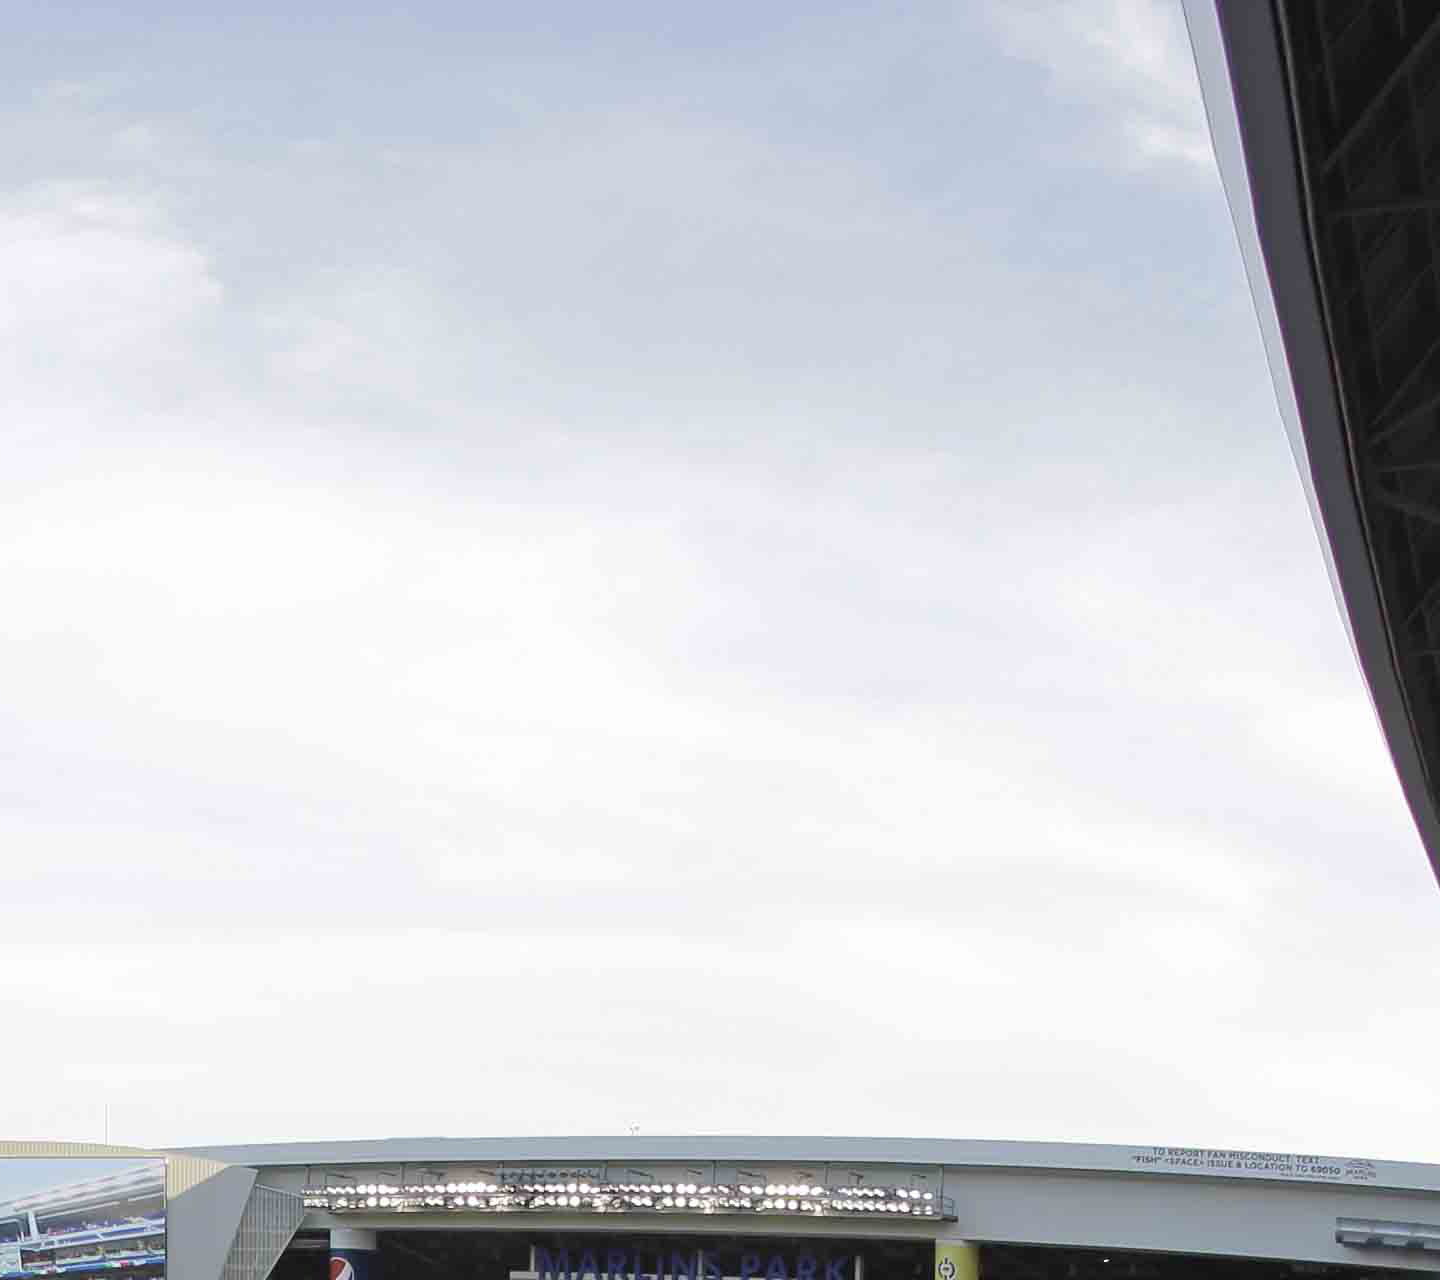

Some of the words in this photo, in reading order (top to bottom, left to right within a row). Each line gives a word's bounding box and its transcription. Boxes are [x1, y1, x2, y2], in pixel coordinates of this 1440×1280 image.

[1208, 1150, 1226, 1160] FAN
[1206, 1159, 1233, 1169] ISSUE
[1244, 1161, 1292, 1172] LOCATION
[1296, 1164, 1308, 1174] TO
